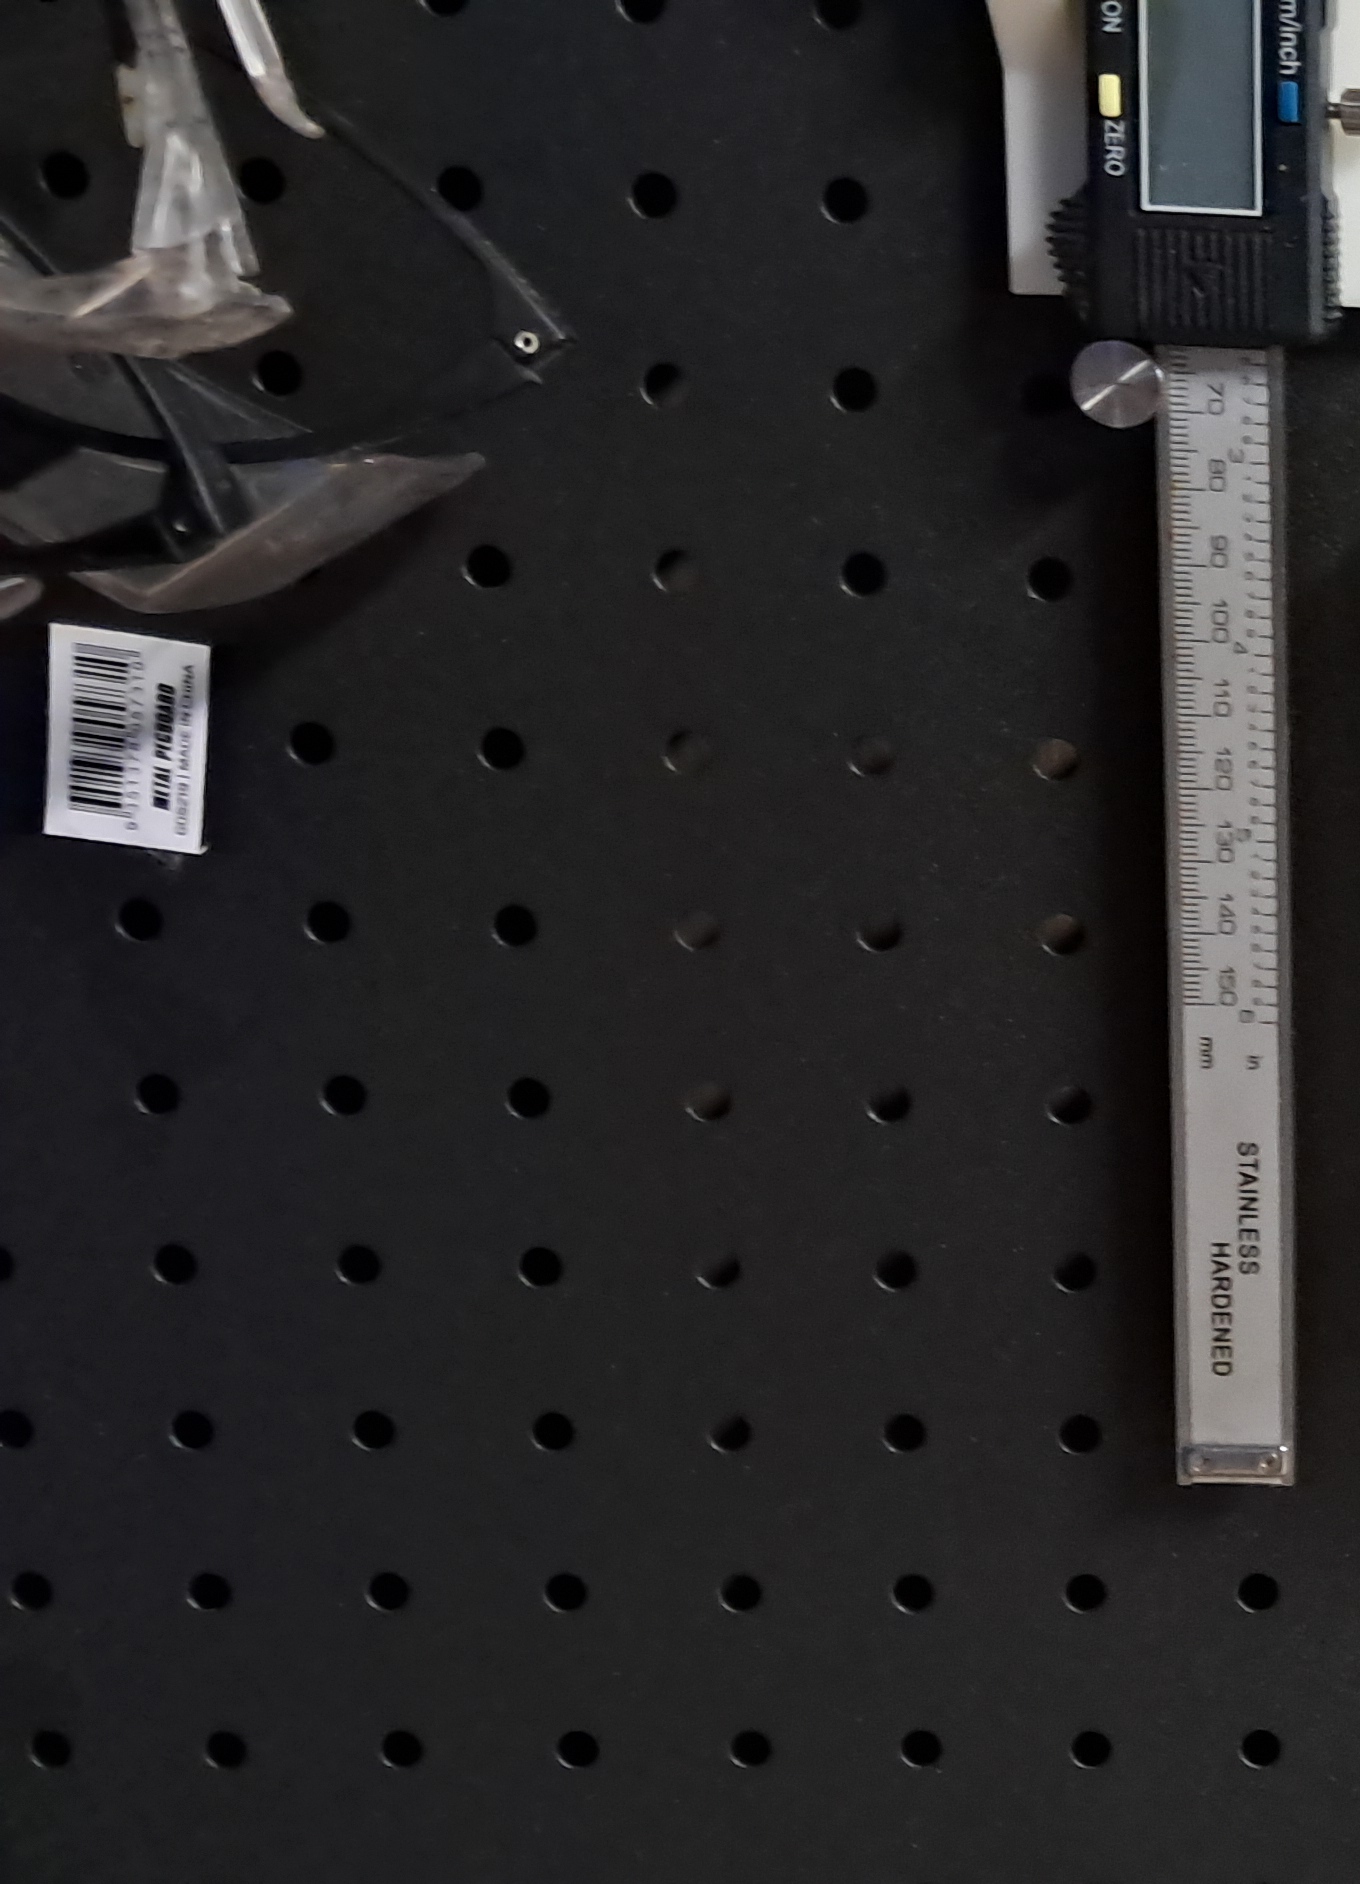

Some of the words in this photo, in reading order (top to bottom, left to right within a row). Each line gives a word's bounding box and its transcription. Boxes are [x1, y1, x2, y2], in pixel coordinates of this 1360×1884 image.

[1100, 0, 1123, 33] ON
[1104, 119, 1125, 176] ZERO
[1207, 383, 1225, 416] 70
[1208, 458, 1227, 493] 80
[1209, 535, 1229, 569] 90
[1211, 599, 1229, 644] 100
[1213, 679, 1232, 719] 110
[1214, 747, 1234, 791] 120
[1216, 821, 1236, 863] 130
[1218, 893, 1238, 936] 140
[1218, 965, 1239, 1006] 150
[1199, 1036, 1214, 1069] mm
[1236, 1140, 1260, 1276] STAINLESS
[1210, 1242, 1234, 1377] HARDENED
